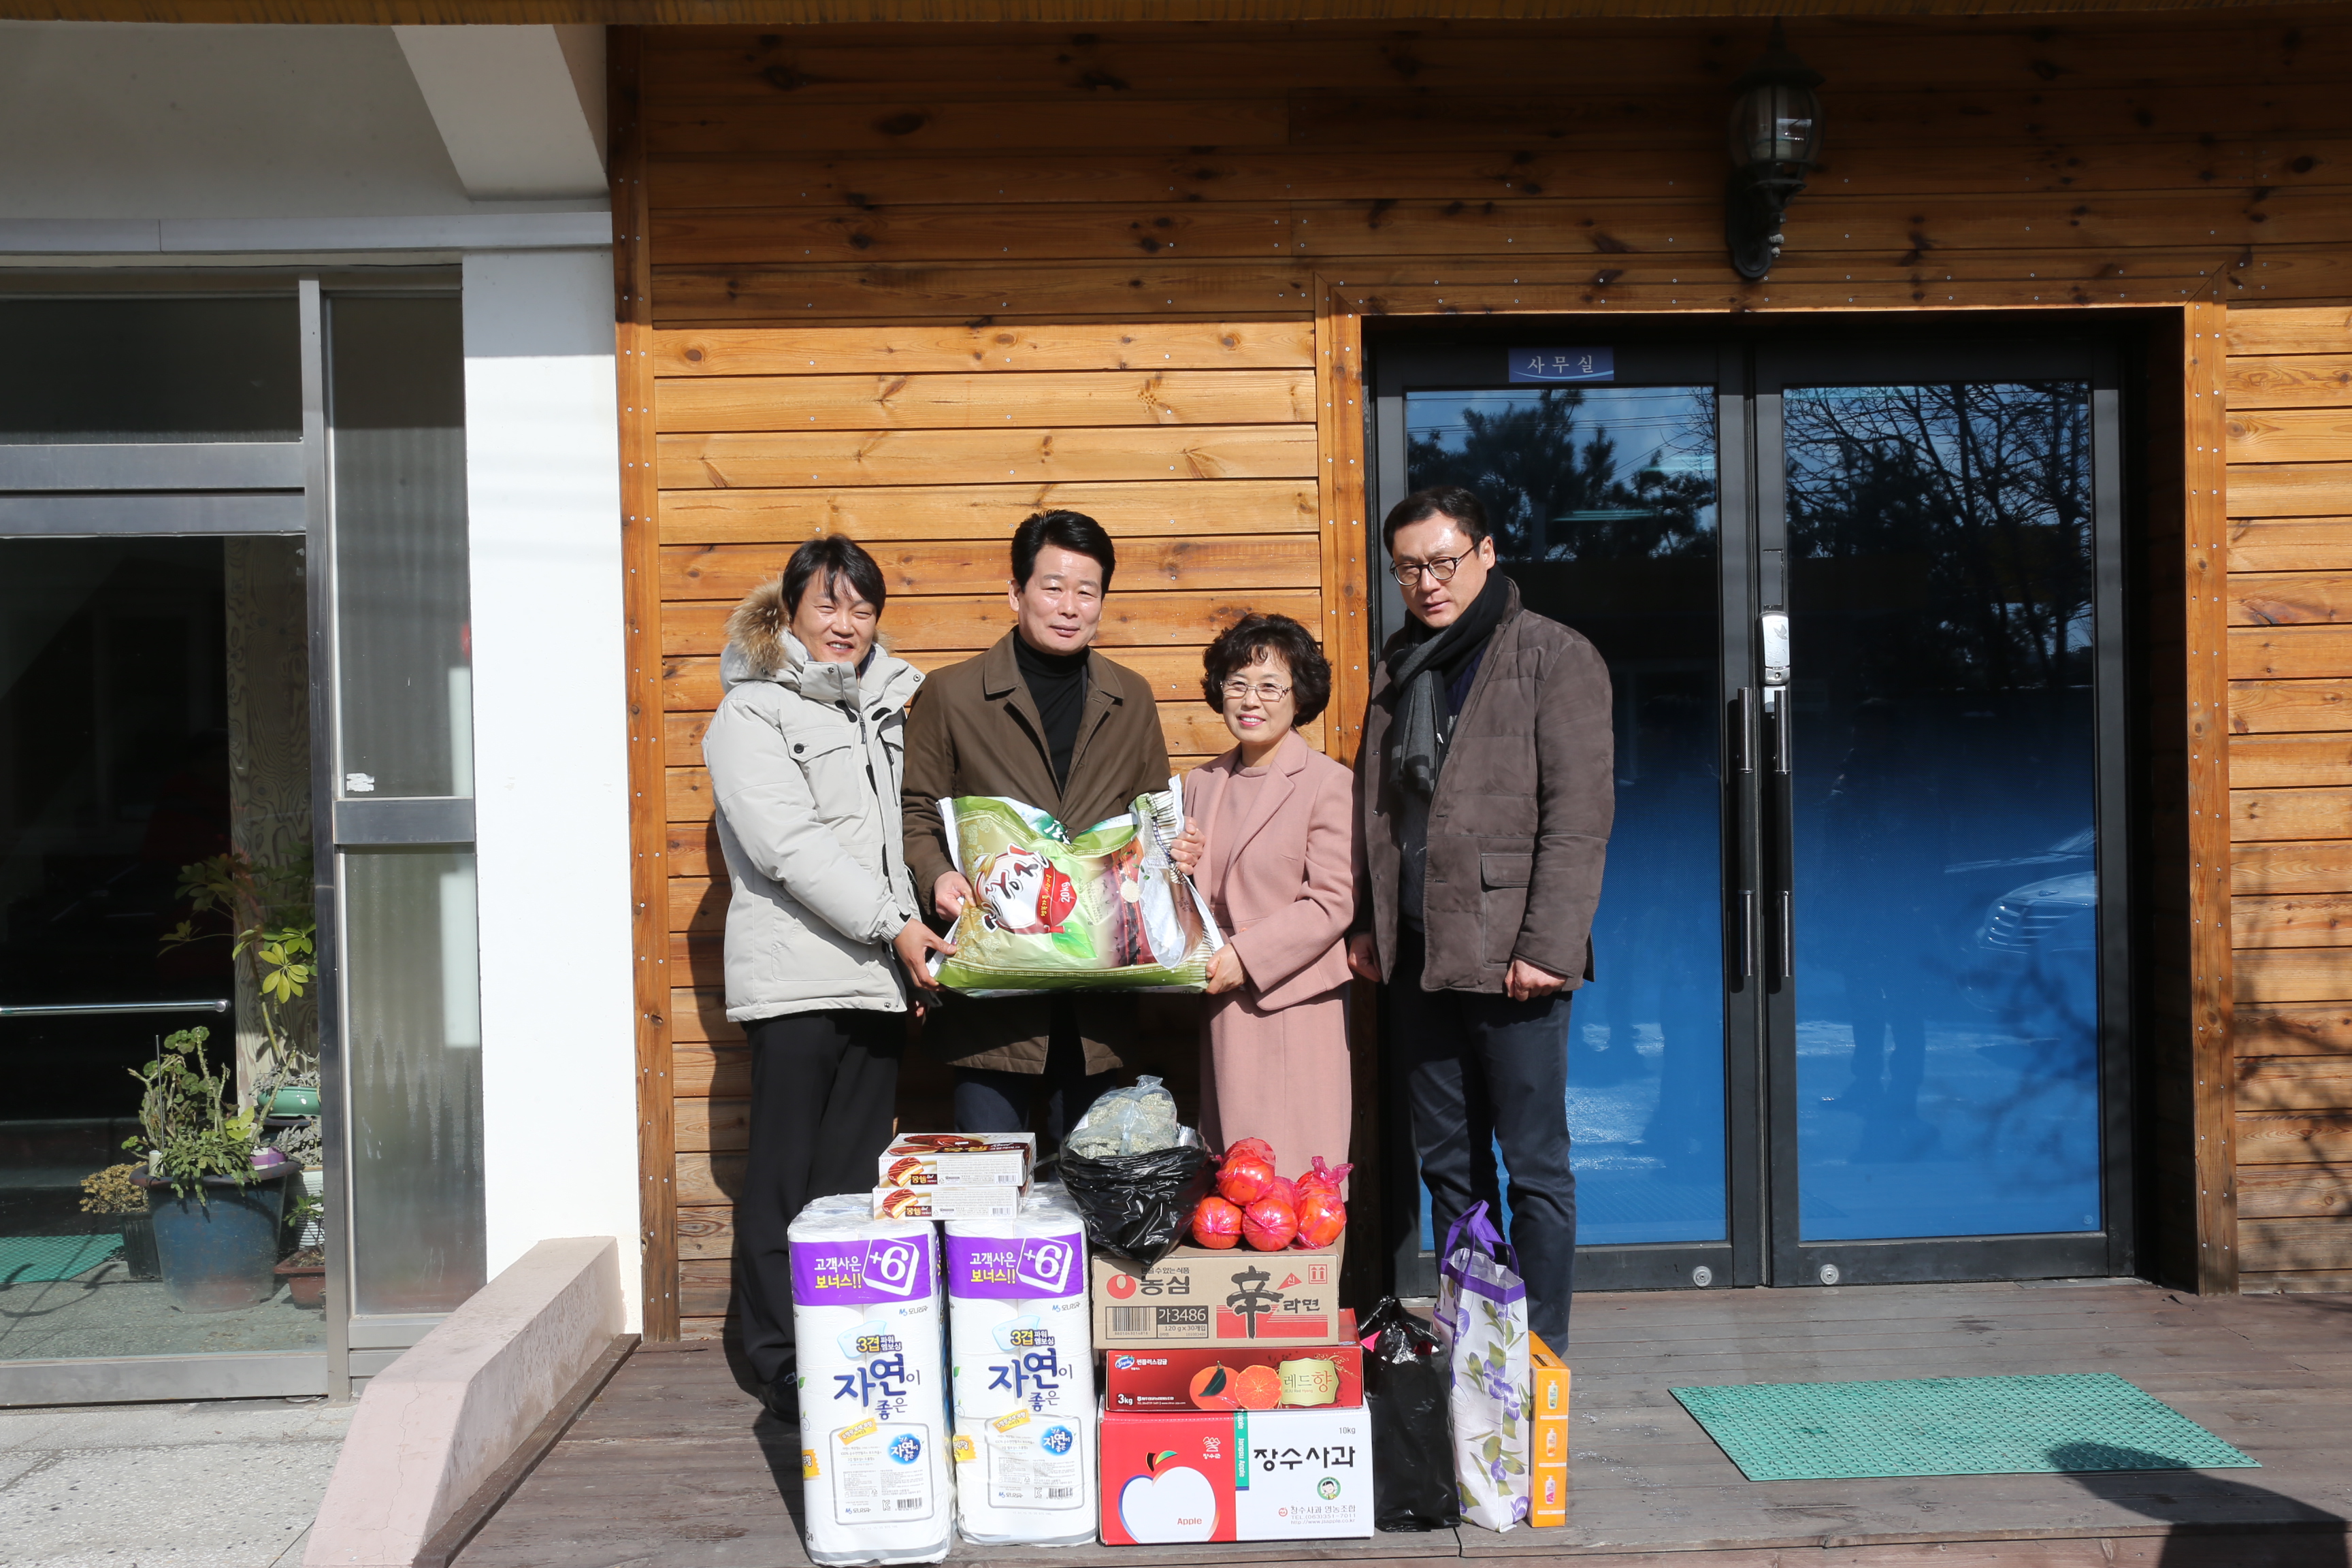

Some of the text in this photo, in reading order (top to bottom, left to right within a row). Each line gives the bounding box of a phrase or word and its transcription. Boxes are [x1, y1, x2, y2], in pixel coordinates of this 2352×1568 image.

[1527, 355, 1594, 374] 사무실
[1060, 881, 1071, 903] 20kg
[912, 1175, 927, 1183] 몽쉘
[906, 1207, 921, 1215] 몽쉘
[814, 1256, 862, 1273] 고객사은
[869, 1245, 909, 1281] +6
[969, 1252, 1016, 1268] 고객사은
[1024, 1244, 1063, 1278] +6
[815, 1273, 862, 1289] 보너스!!
[970, 1269, 1016, 1284] 보너스!!
[1287, 1276, 1296, 1285] 신
[1139, 1275, 1190, 1296] 농심
[1226, 1264, 1284, 1339] 辛
[1283, 1298, 1320, 1314] 라면
[1158, 1308, 1206, 1323] 가3486
[856, 1336, 880, 1352] 3겹
[880, 1335, 895, 1343] 파워
[1011, 1330, 1033, 1345] 3겹
[1034, 1337, 1054, 1345] 엠보싱
[881, 1343, 902, 1351] 엠보싱
[1284, 1370, 1333, 1392] 레드향
[1028, 1390, 1060, 1411] 좋은
[1117, 1393, 1133, 1405] 3kg
[875, 1397, 908, 1420] 좋은
[1339, 1426, 1356, 1435] 10kg
[1254, 1446, 1356, 1472] 장수사과
[1290, 1505, 1356, 1514] 장수사과 영농조합
[1177, 1517, 1203, 1526] Apple
